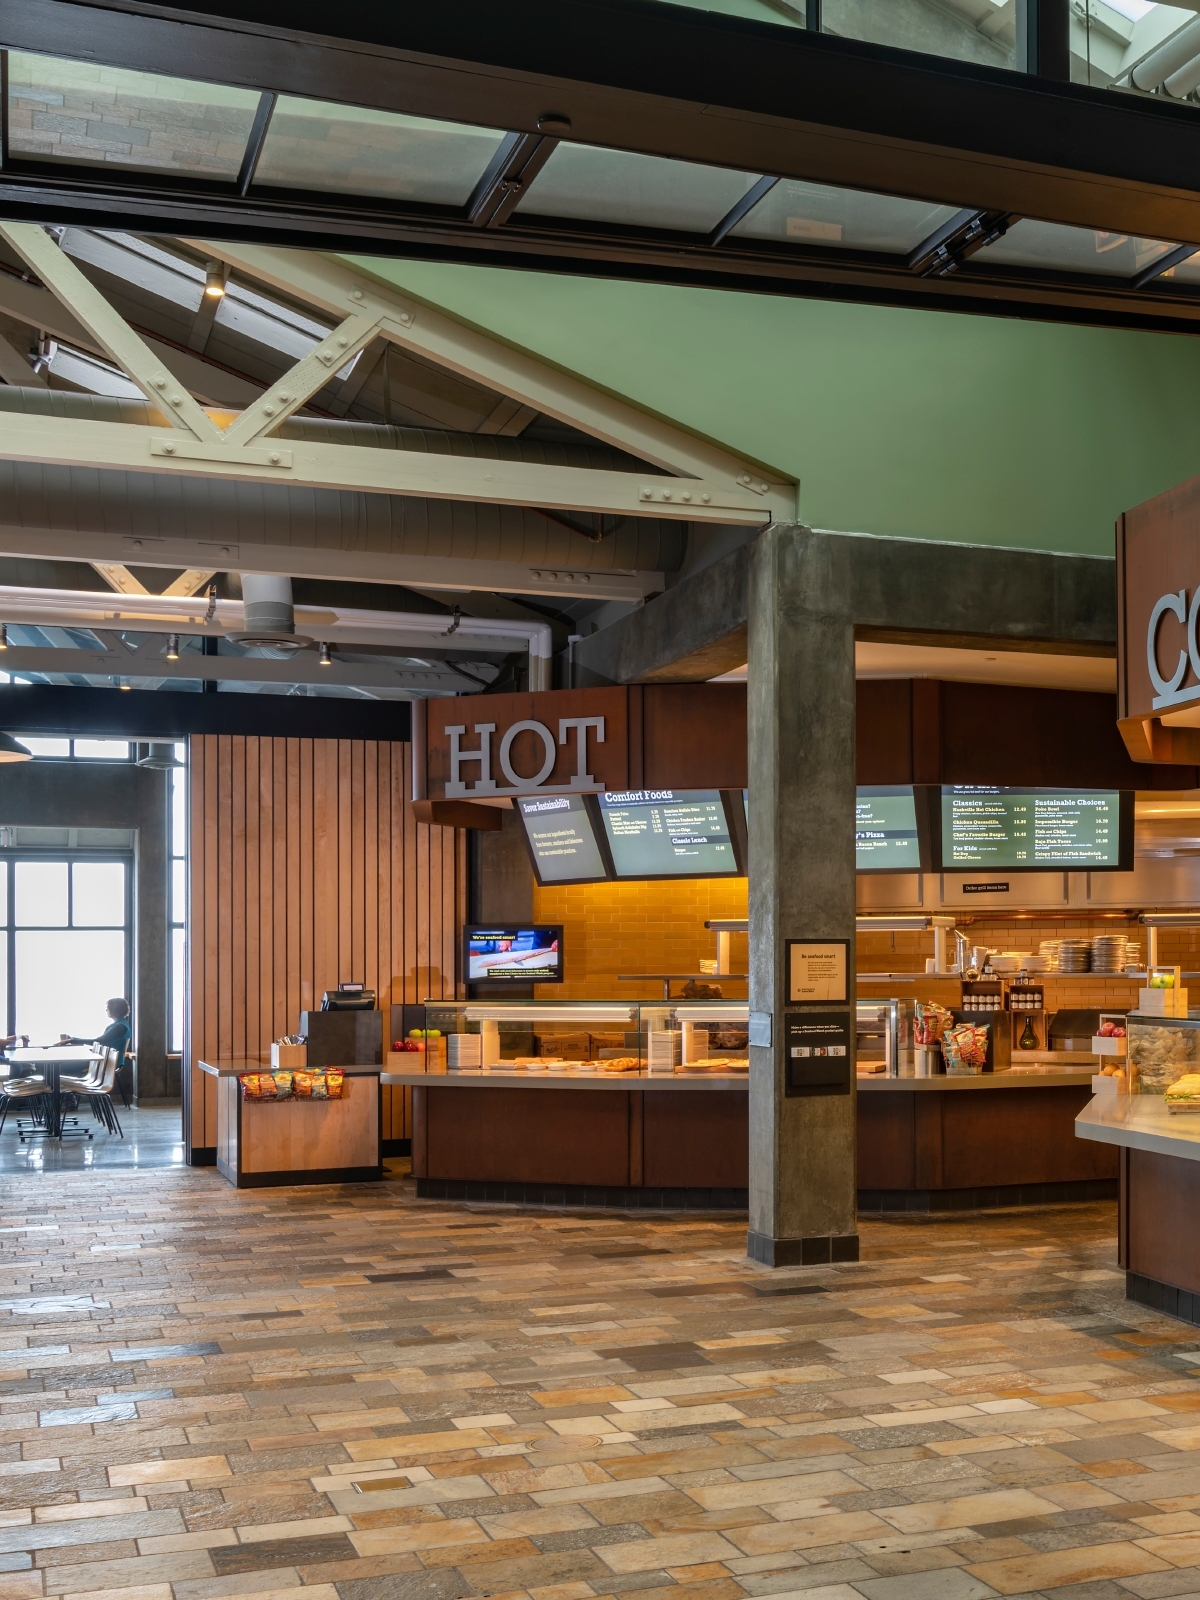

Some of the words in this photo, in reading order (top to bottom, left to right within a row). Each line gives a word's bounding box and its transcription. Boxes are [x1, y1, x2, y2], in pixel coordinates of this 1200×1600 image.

[445, 716, 606, 799] HOT
[605, 791, 643, 802] Comfort
[644, 790, 673, 800] Foods
